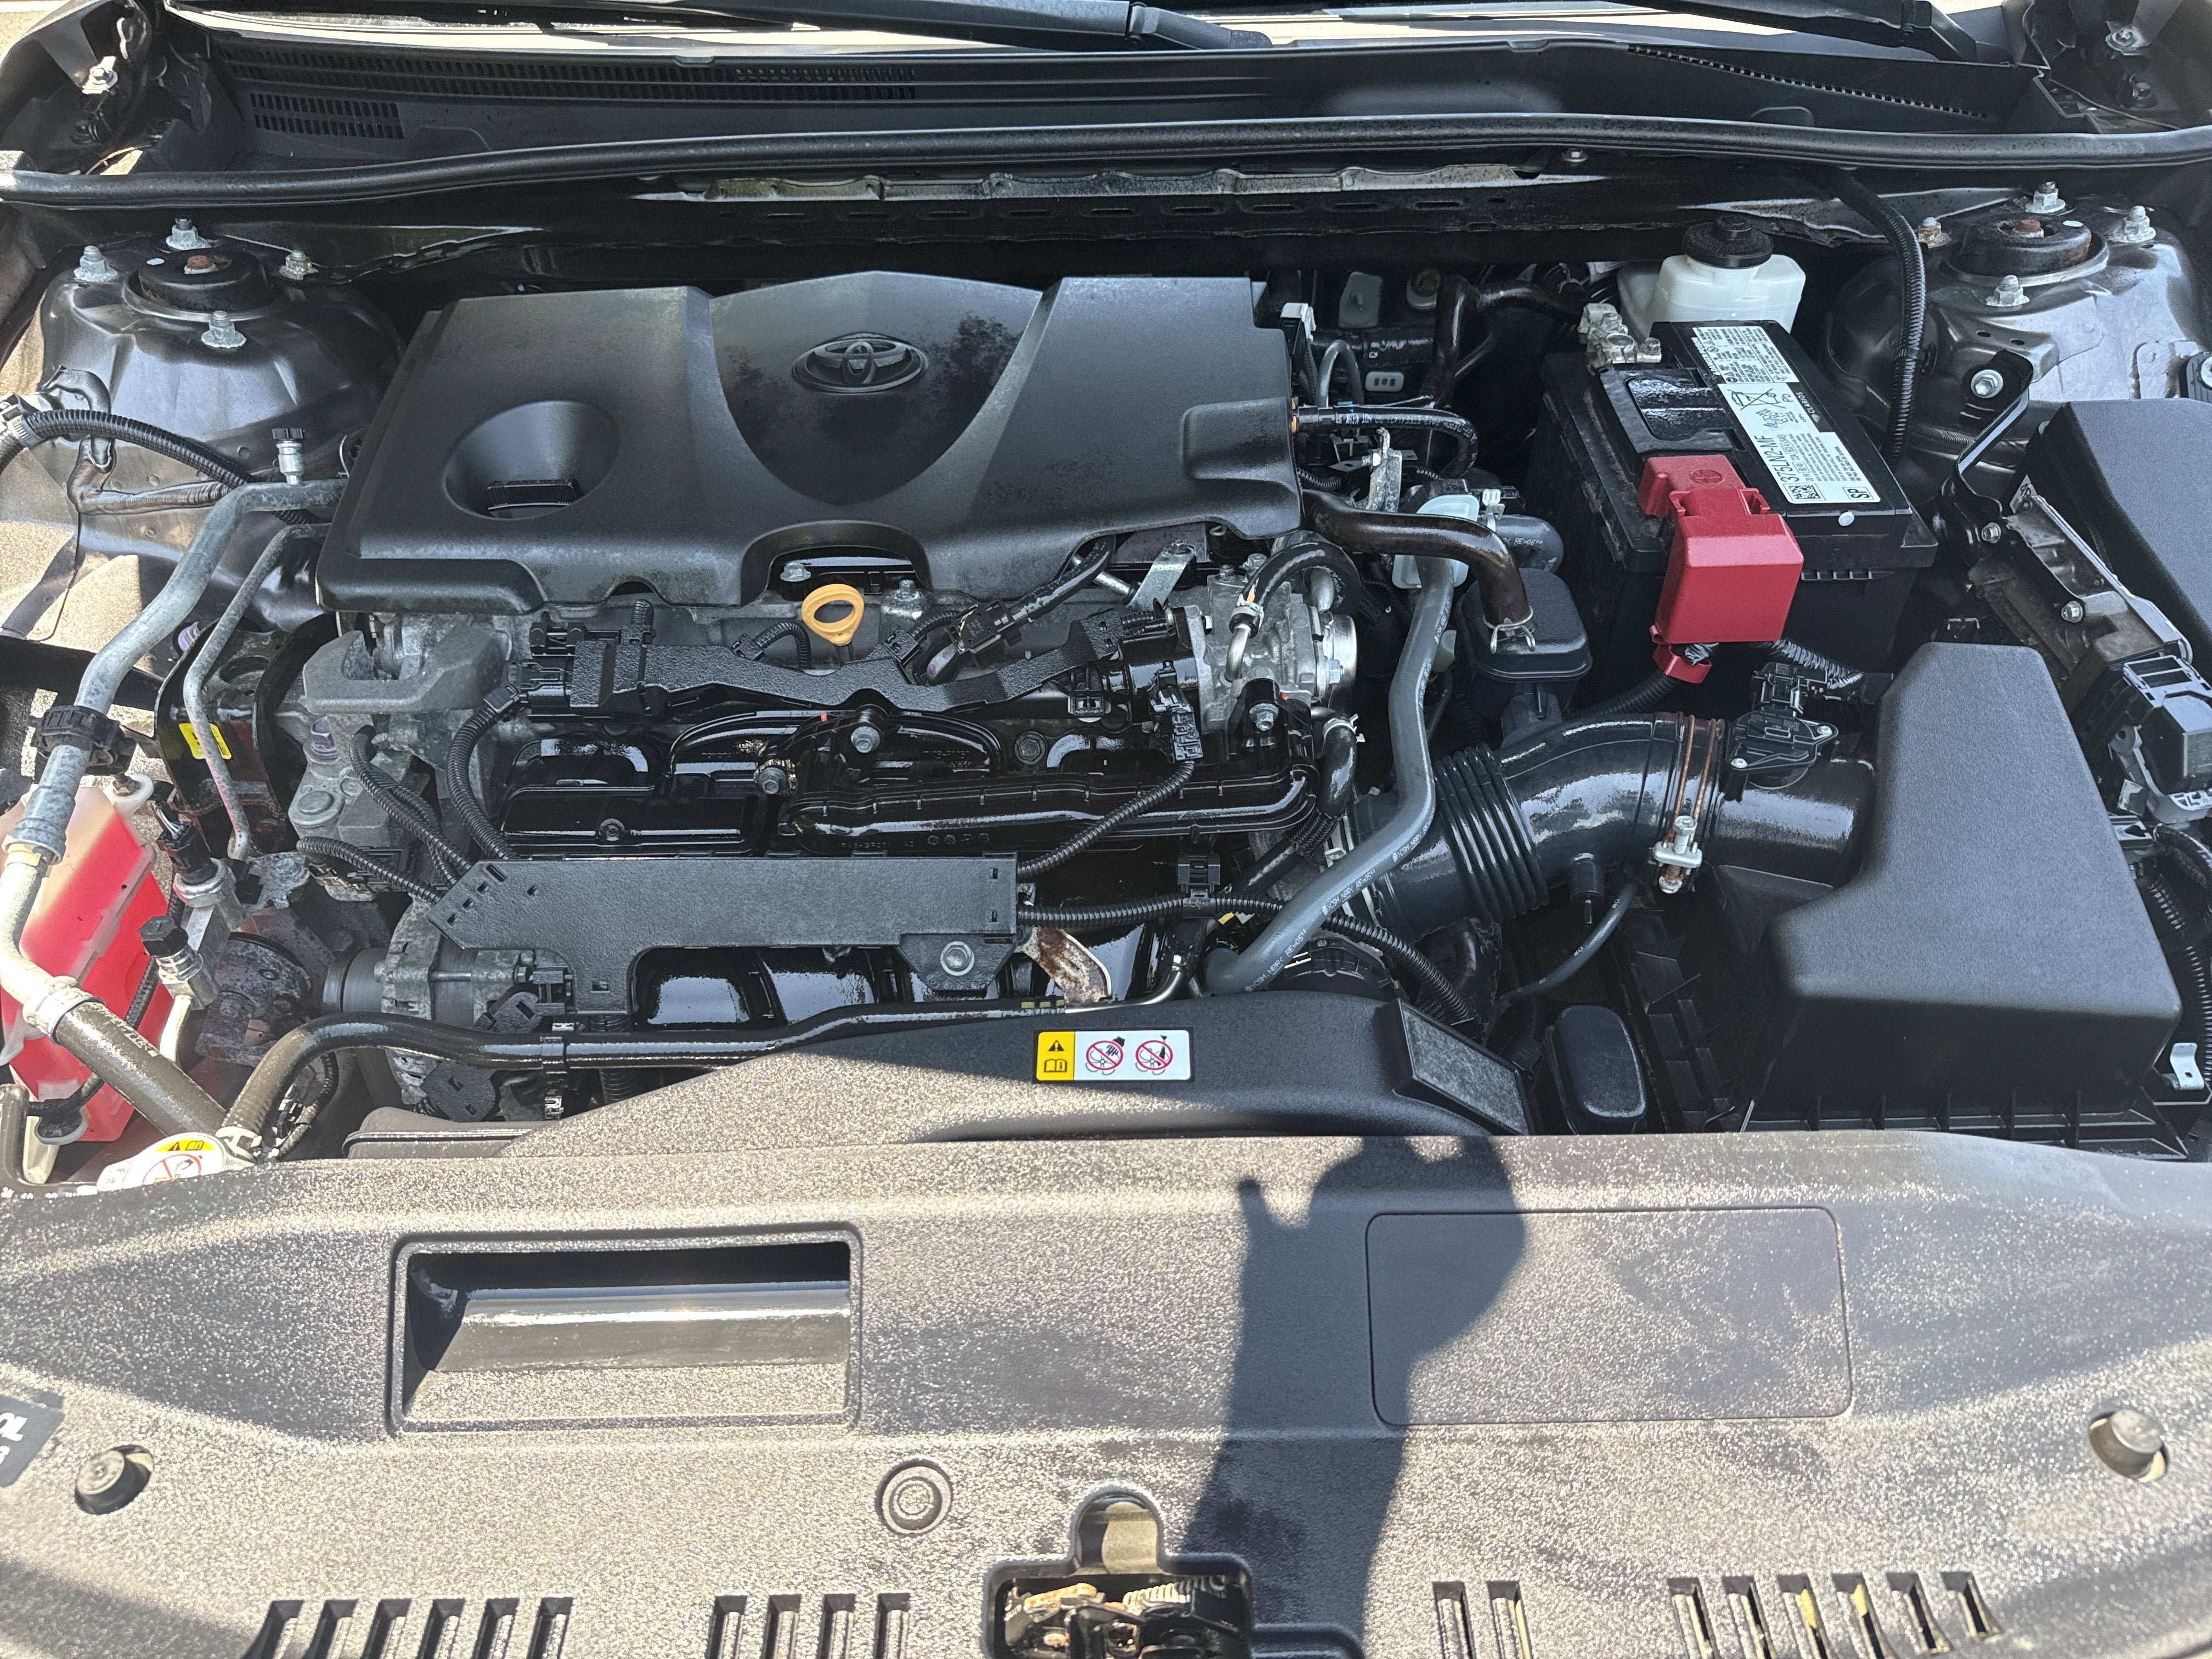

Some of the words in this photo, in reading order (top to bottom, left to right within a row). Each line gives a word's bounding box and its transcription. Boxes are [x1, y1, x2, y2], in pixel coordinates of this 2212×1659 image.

[1796, 392, 1815, 414] CLARIOS
[1755, 436, 1799, 482] 375LN2-MF
[1847, 488, 1870, 499] SP
